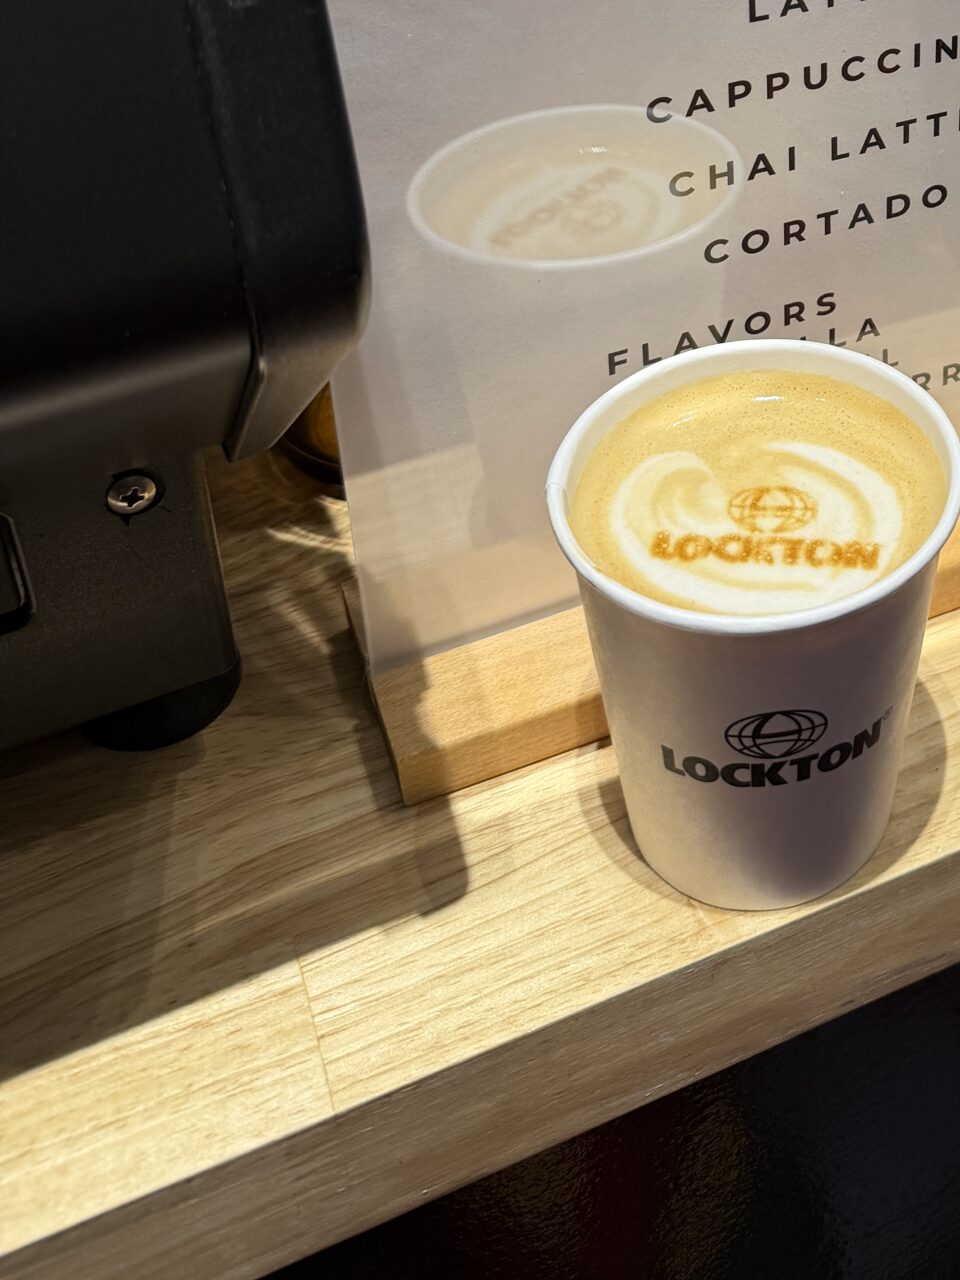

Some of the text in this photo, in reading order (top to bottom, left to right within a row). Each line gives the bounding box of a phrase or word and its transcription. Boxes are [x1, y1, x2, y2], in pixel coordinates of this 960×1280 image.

[668, 146, 798, 197] CHAI
[703, 183, 948, 264] CORTADO
[607, 292, 837, 376] FLAVORS
[649, 531, 880, 570] LOCKTON
